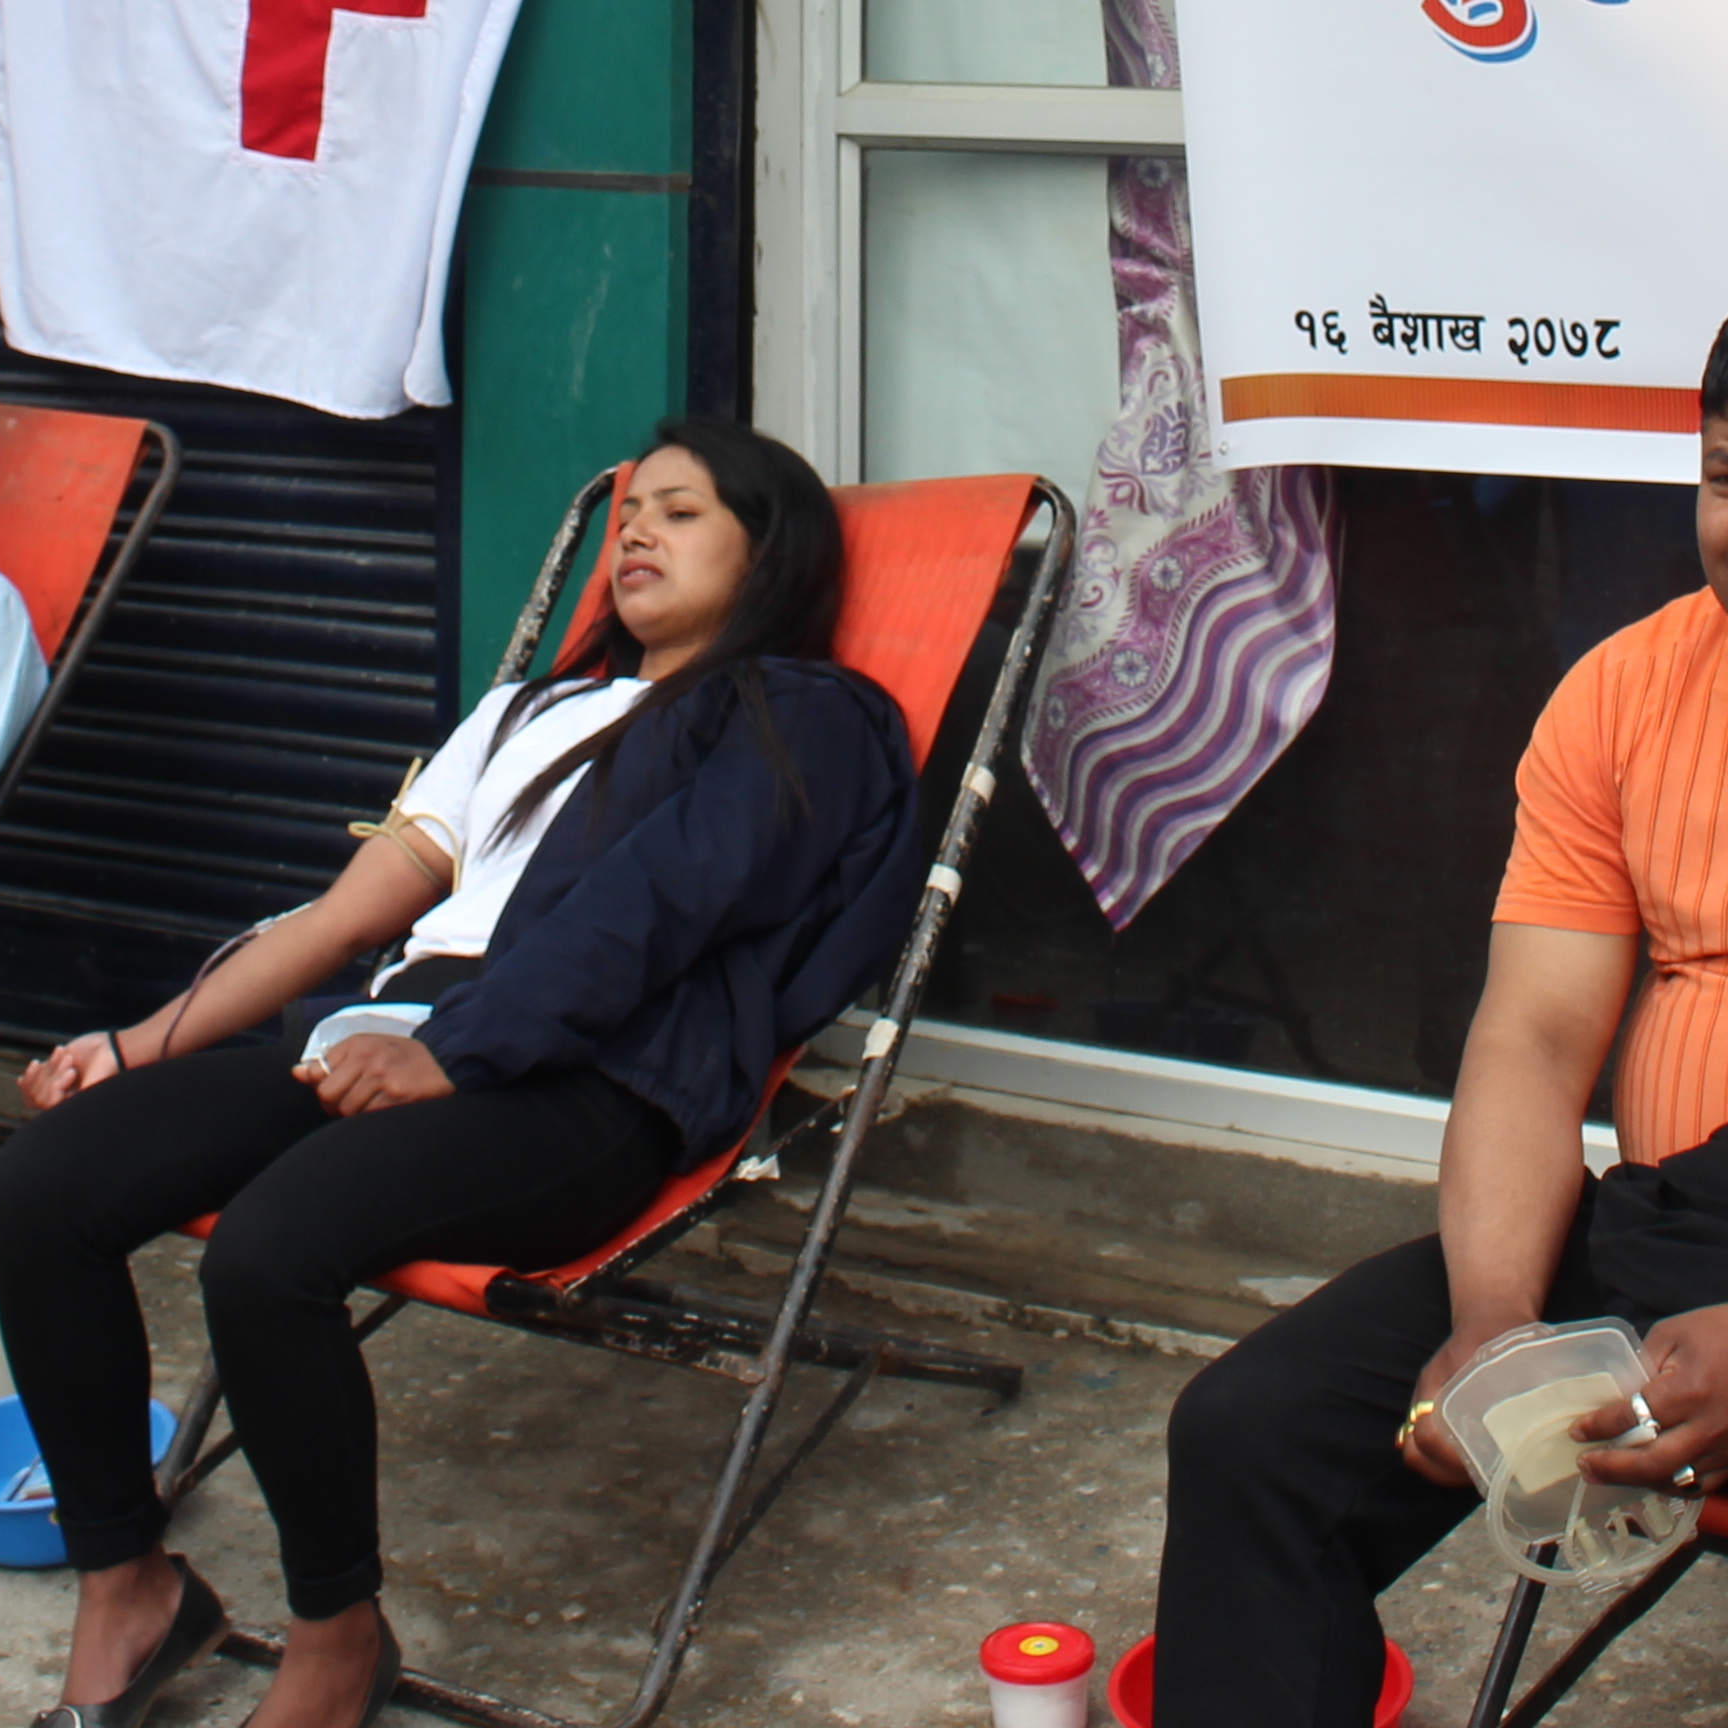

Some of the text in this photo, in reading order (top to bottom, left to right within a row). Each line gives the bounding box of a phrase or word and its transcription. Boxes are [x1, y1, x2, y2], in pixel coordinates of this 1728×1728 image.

[1294, 293, 1622, 364] १६ बैशाख २०७८
